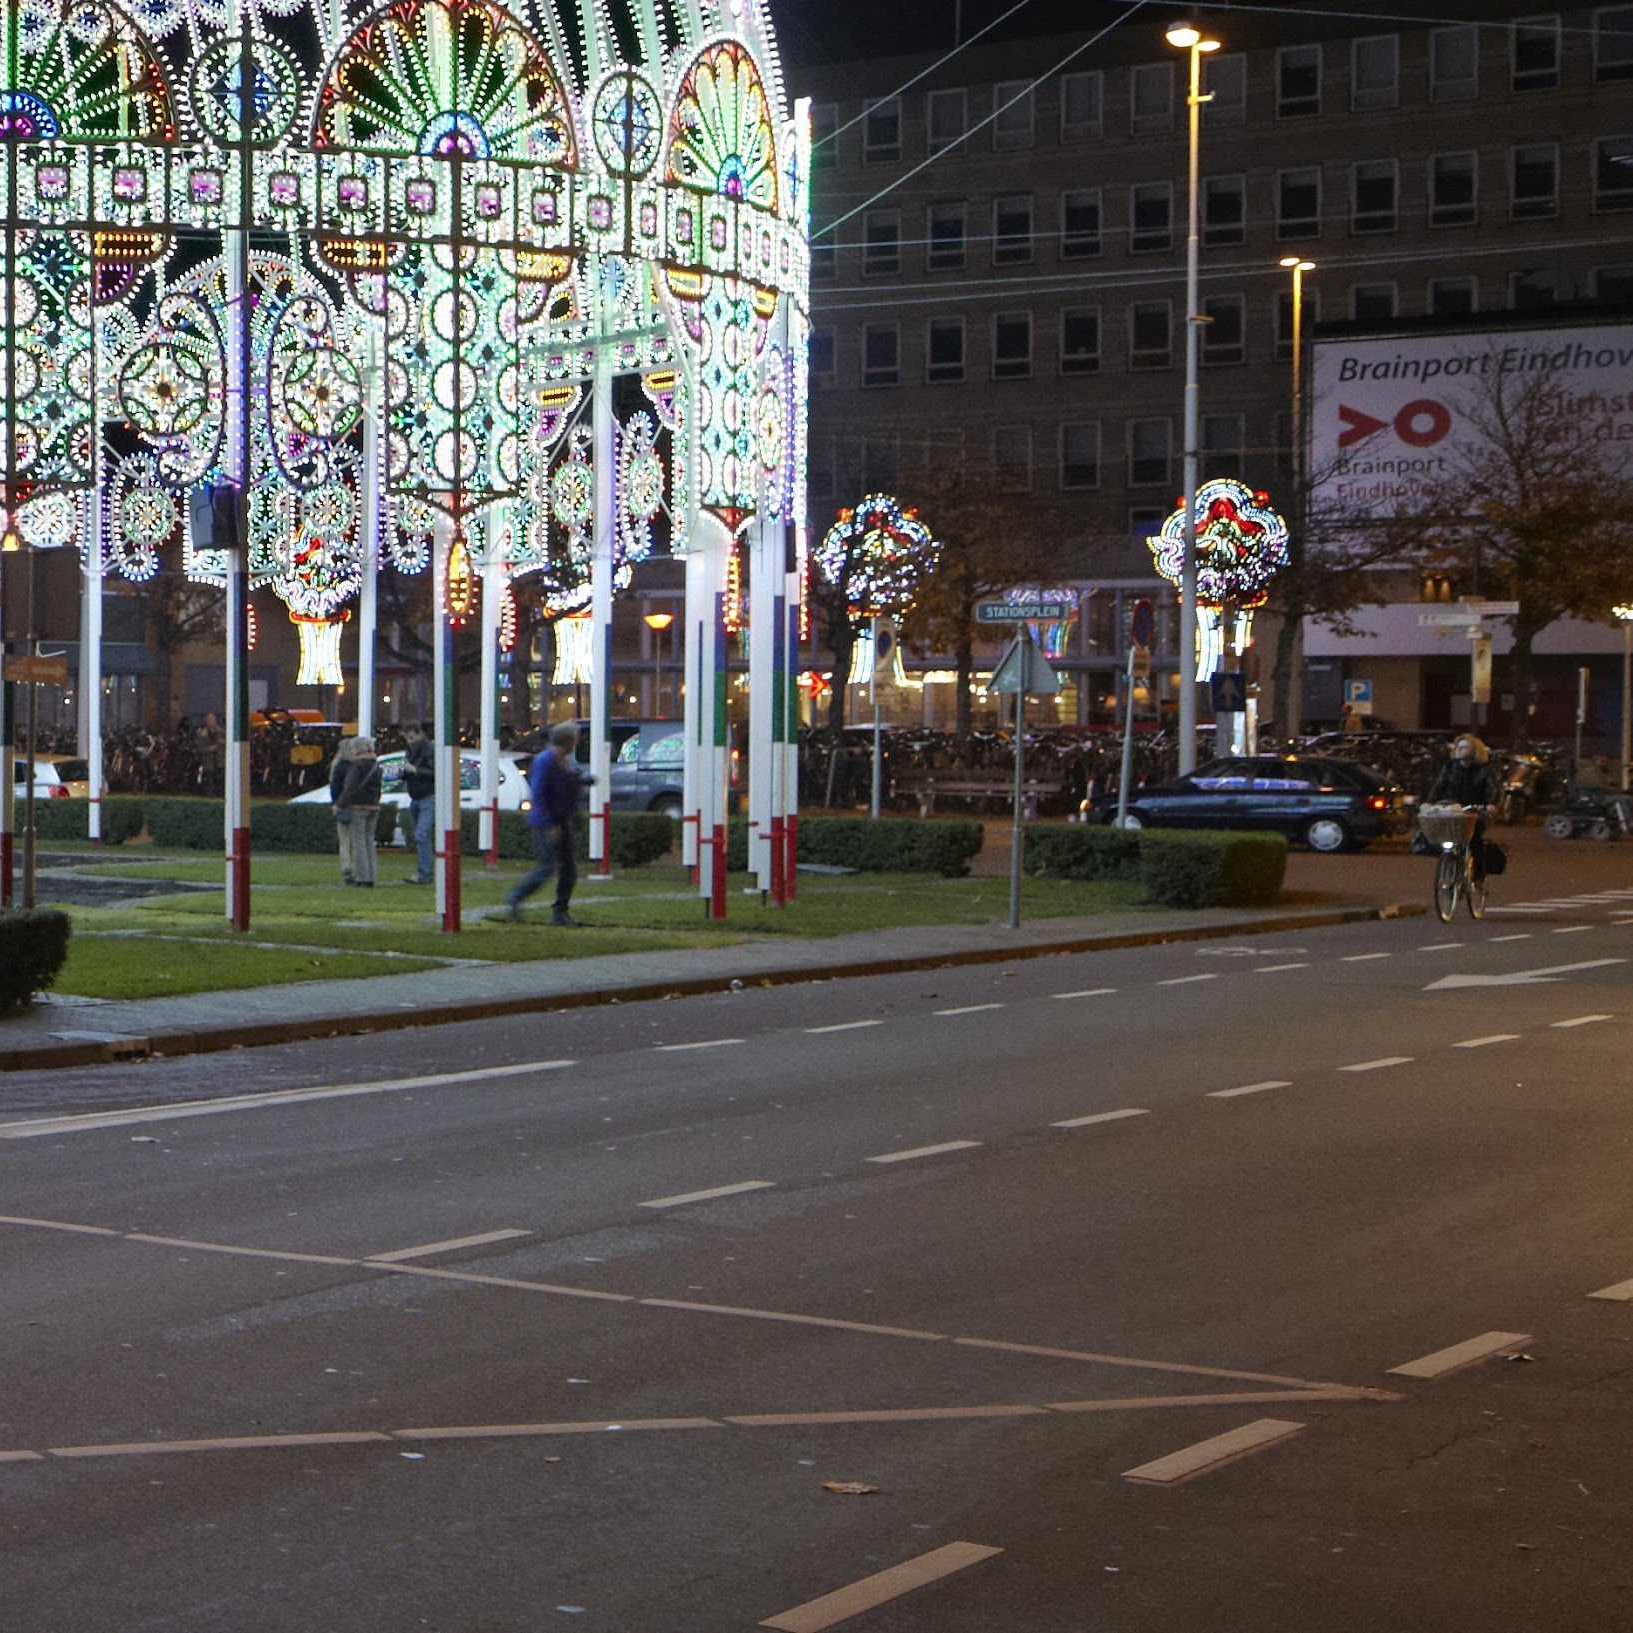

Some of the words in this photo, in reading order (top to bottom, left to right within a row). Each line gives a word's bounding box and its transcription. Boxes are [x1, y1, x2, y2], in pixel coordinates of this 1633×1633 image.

[1338, 353, 1491, 384] Brainport
[1500, 343, 1633, 374] Eindhov
[1338, 456, 1447, 478] Brainport
[985, 605, 1060, 619] STATIONSPLEIN
[1351, 682, 1366, 699] P
